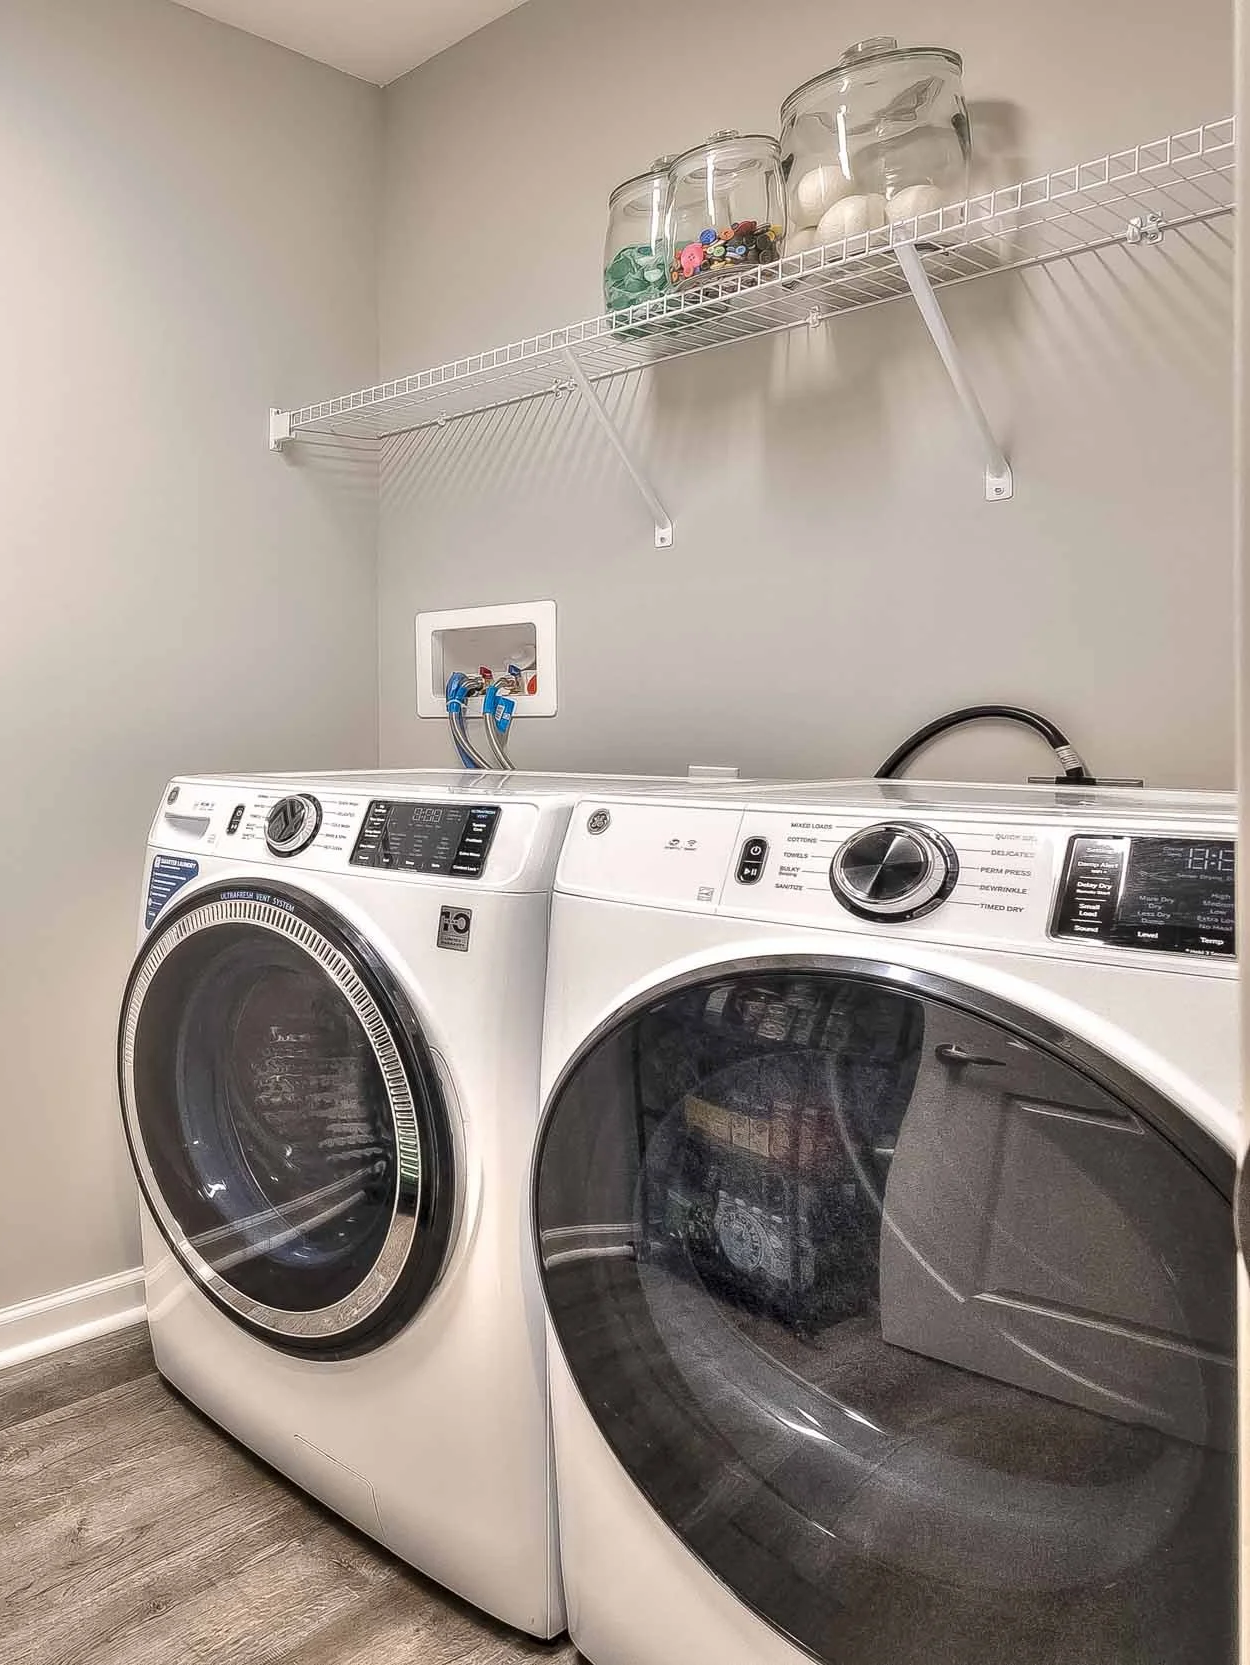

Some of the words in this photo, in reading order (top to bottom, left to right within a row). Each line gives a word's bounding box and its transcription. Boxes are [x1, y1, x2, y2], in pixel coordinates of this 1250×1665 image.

[787, 836, 817, 844] COTTONS
[783, 851, 809, 859] TOWELS
[980, 866, 1004, 875] PERM
[1004, 868, 1032, 877] PRESS
[775, 883, 804, 891] SANITIZE
[1076, 881, 1098, 889] Delay
[979, 884, 1029, 895] DEWRINKLE
[220, 891, 254, 900] ULTRAFRESH
[256, 893, 271, 902] VENT
[272, 897, 295, 913] SYSTEM
[1160, 896, 1174, 905] Dry
[980, 903, 1006, 911] TIMED
[1006, 905, 1025, 913] DRY
[1078, 903, 1101, 911] Small
[1078, 910, 1098, 918] Load
[1156, 911, 1171, 919] Dry
[1196, 915, 1219, 923] Extra
[1073, 924, 1099, 933] Sound
[1137, 931, 1159, 939] Level
[1200, 936, 1225, 946] Temp
